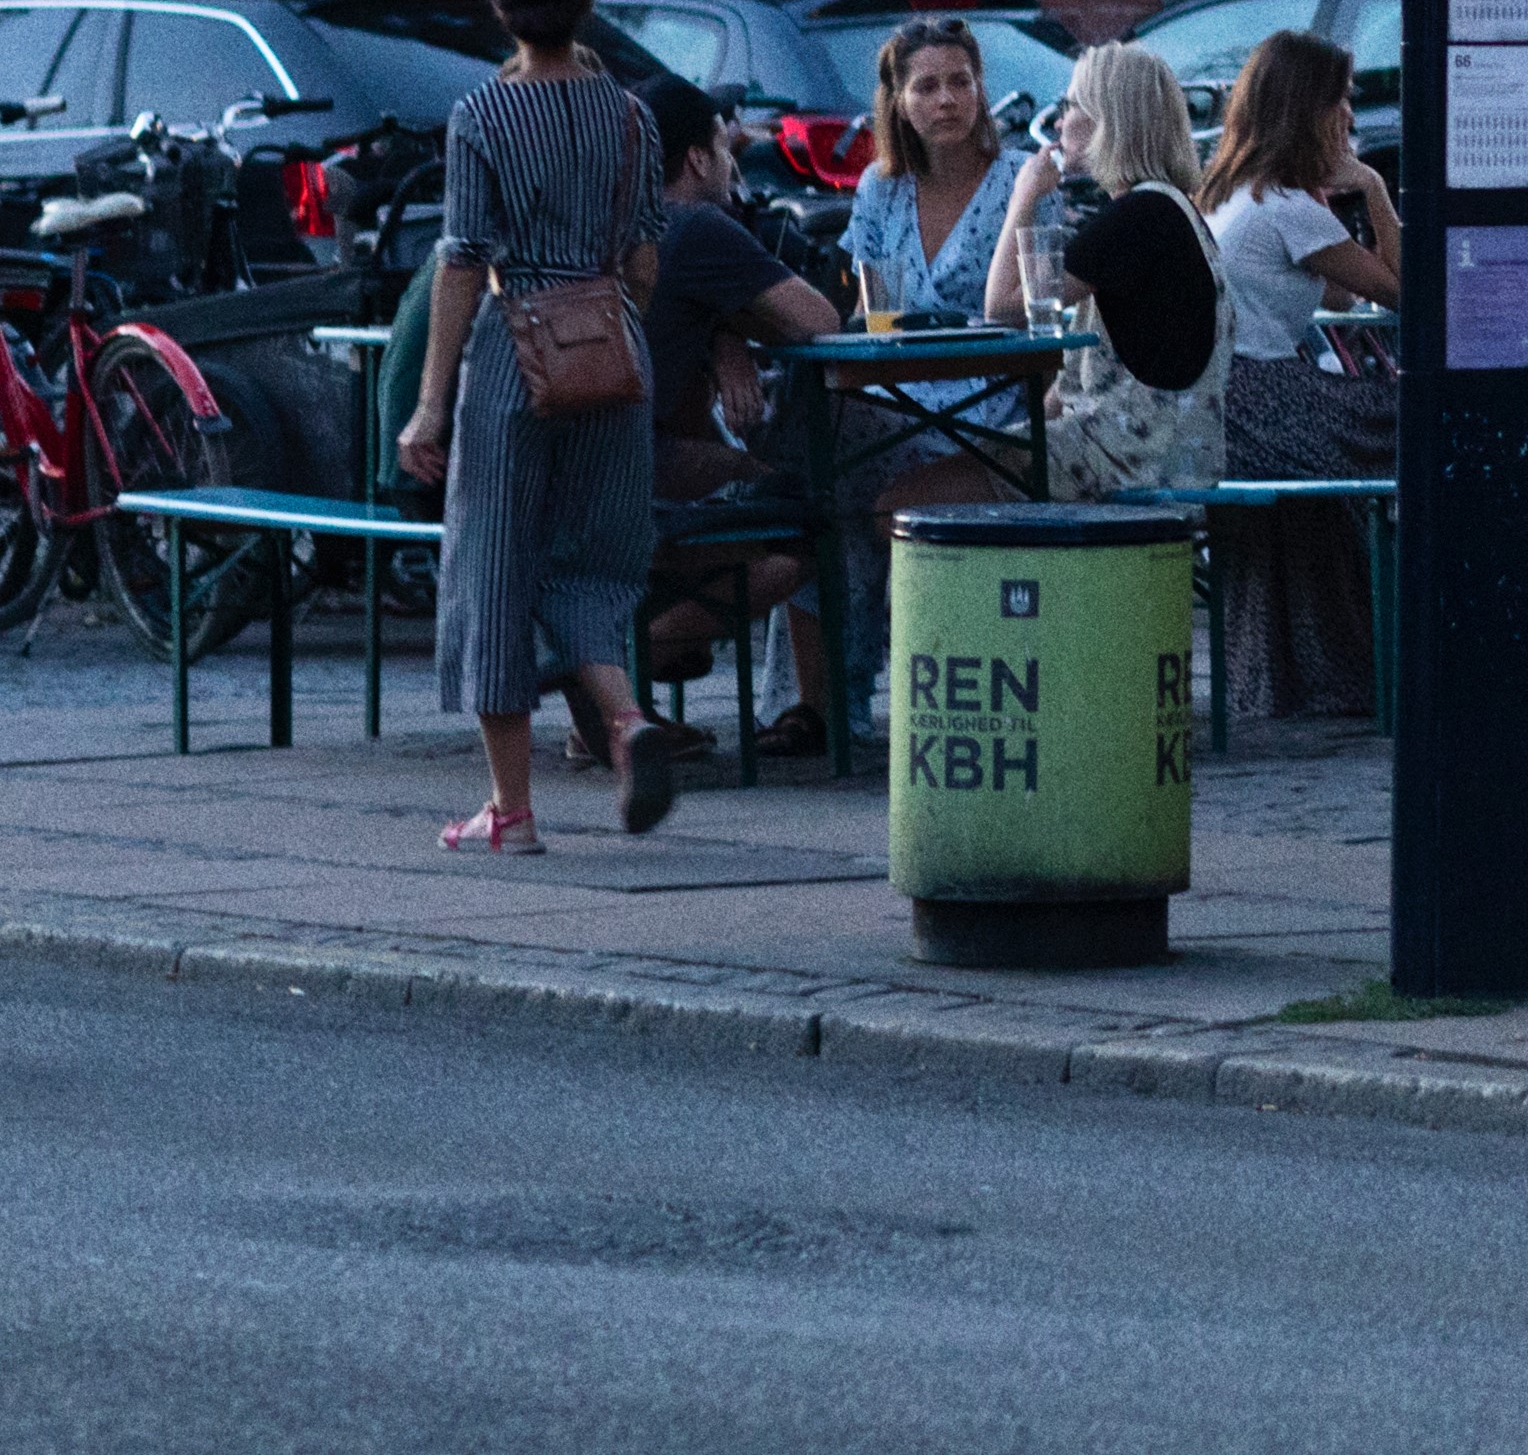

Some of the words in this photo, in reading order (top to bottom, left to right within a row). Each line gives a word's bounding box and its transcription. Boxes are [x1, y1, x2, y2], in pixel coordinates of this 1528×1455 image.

[1455, 54, 1471, 68] 66
[910, 654, 1039, 712] REN
[910, 732, 1038, 792] KBH
